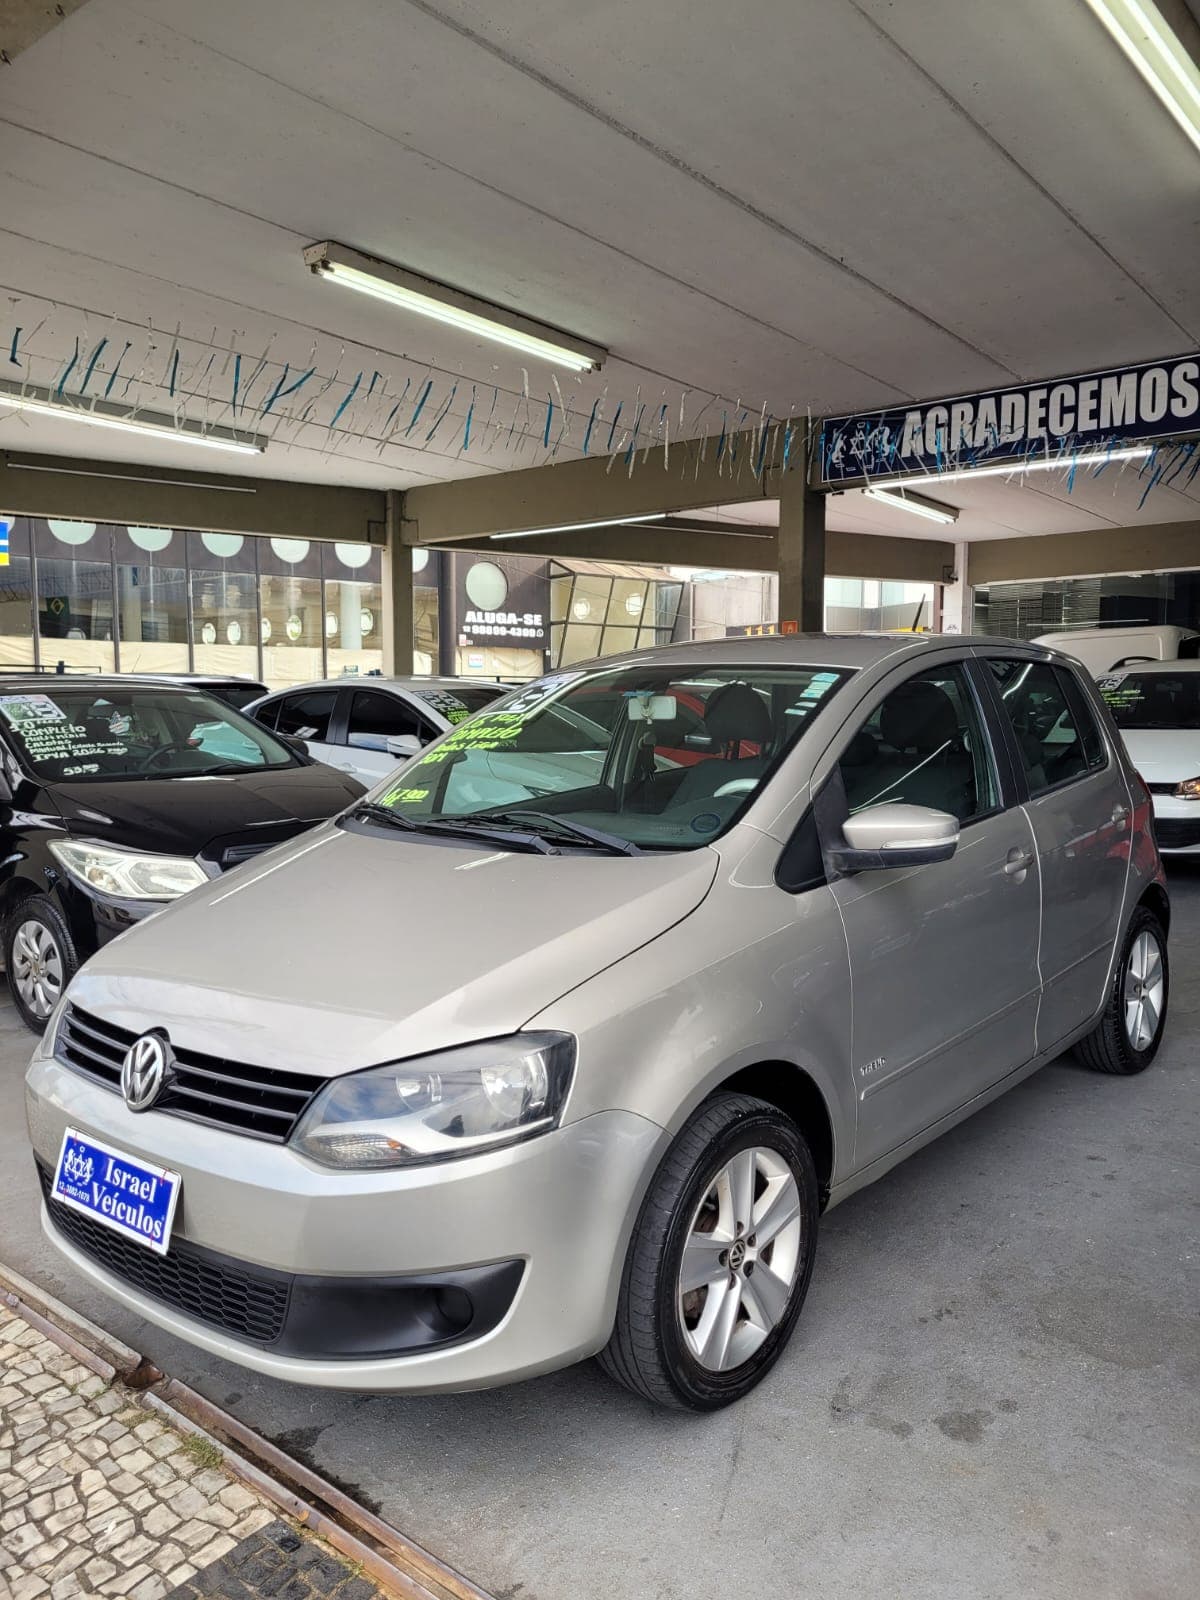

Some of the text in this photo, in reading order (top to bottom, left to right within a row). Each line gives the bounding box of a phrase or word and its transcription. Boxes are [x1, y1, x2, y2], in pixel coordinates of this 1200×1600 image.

[901, 361, 1199, 458] AGRADECEMOS
[465, 610, 542, 626] ALUGA-SE
[103, 1157, 158, 1203] Israel
[92, 1181, 163, 1239] Veículos
